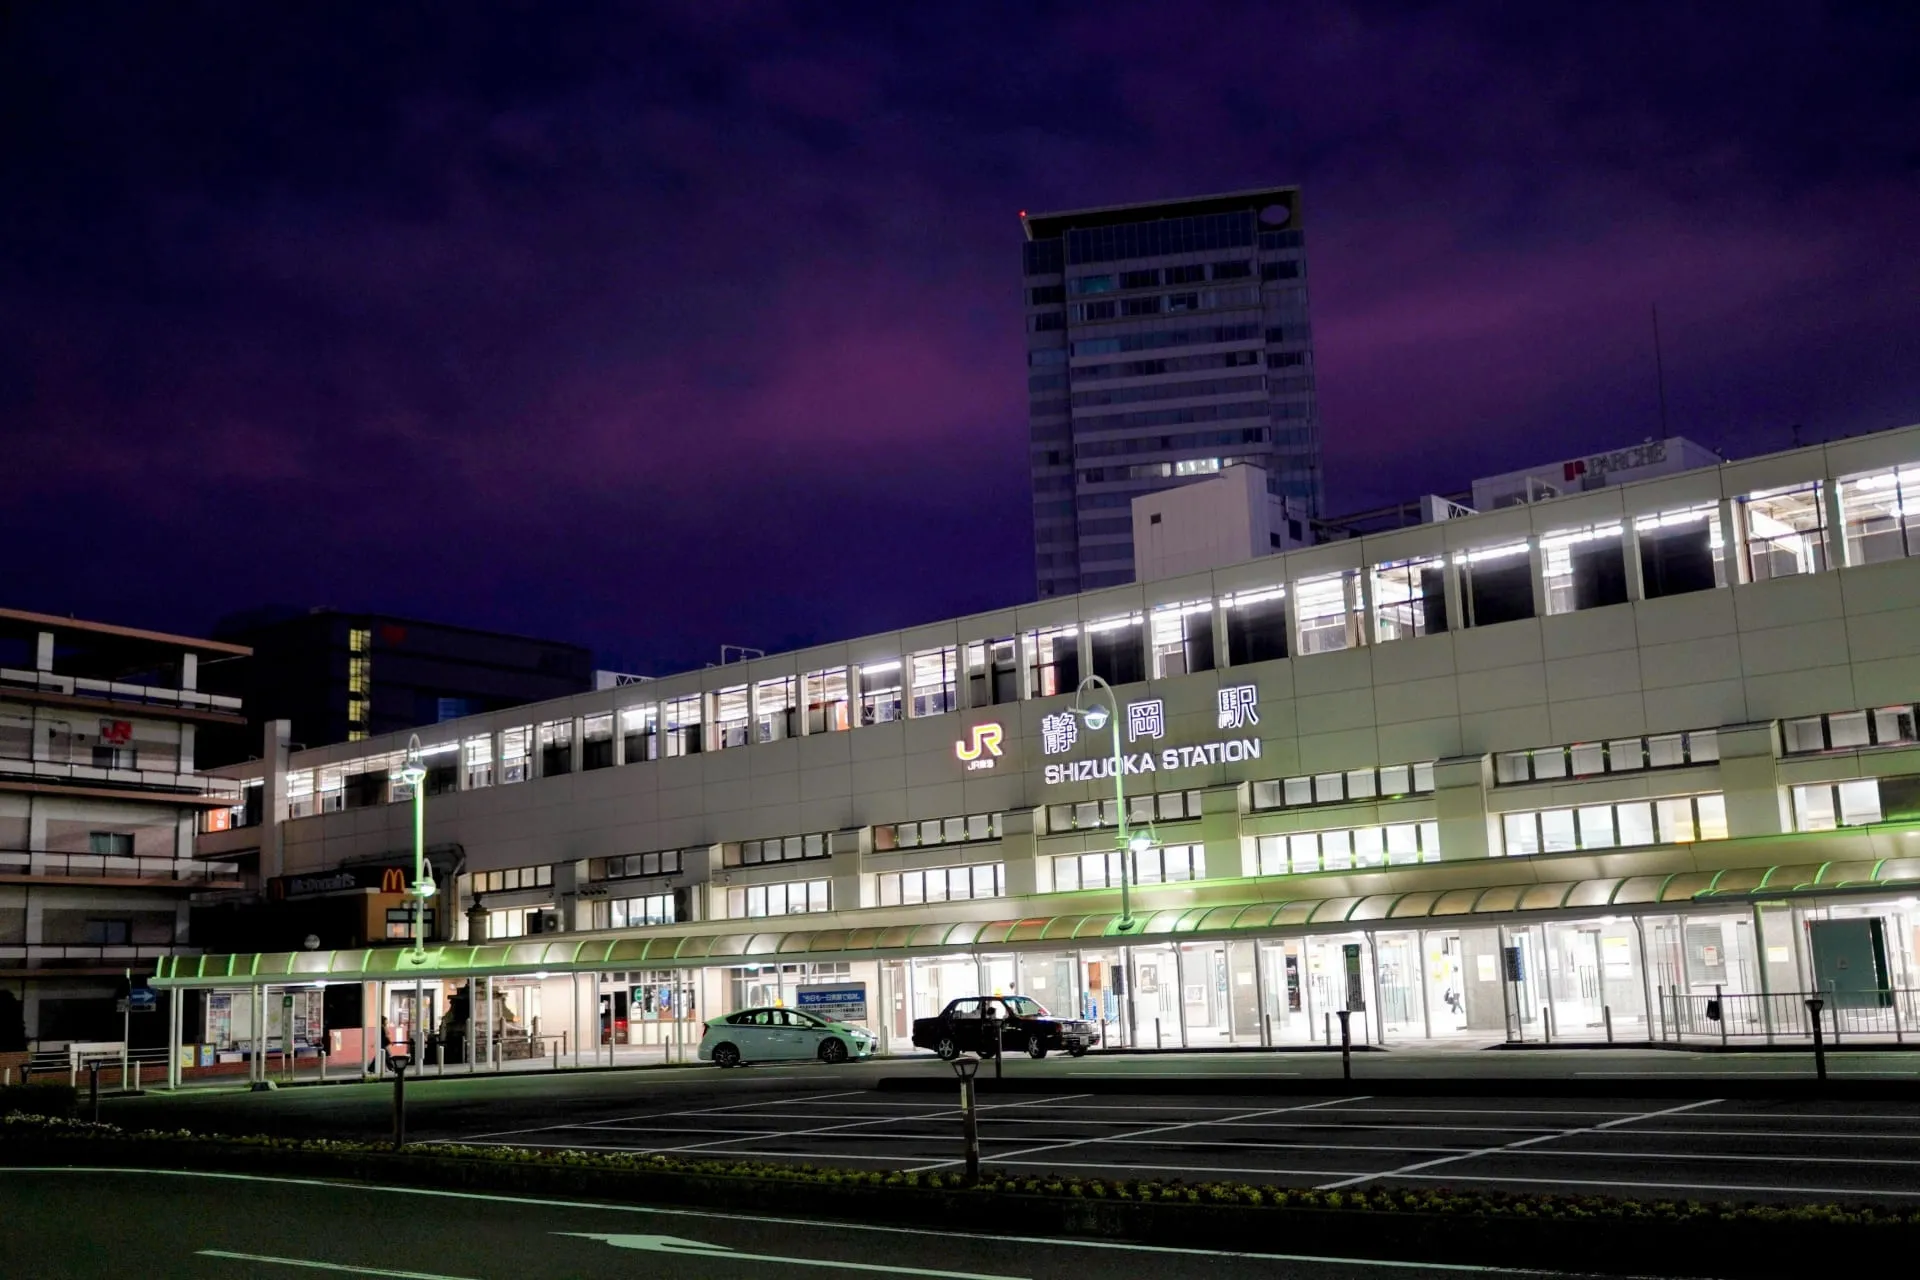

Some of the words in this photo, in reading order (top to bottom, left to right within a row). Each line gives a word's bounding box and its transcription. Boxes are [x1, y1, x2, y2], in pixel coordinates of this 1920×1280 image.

[1588, 442, 1667, 476] PARCHE
[1041, 685, 1259, 754] 静岡駅
[956, 723, 1003, 760] JR
[1045, 752, 1156, 784] SHIZUOKA
[1162, 738, 1262, 770] STATION
